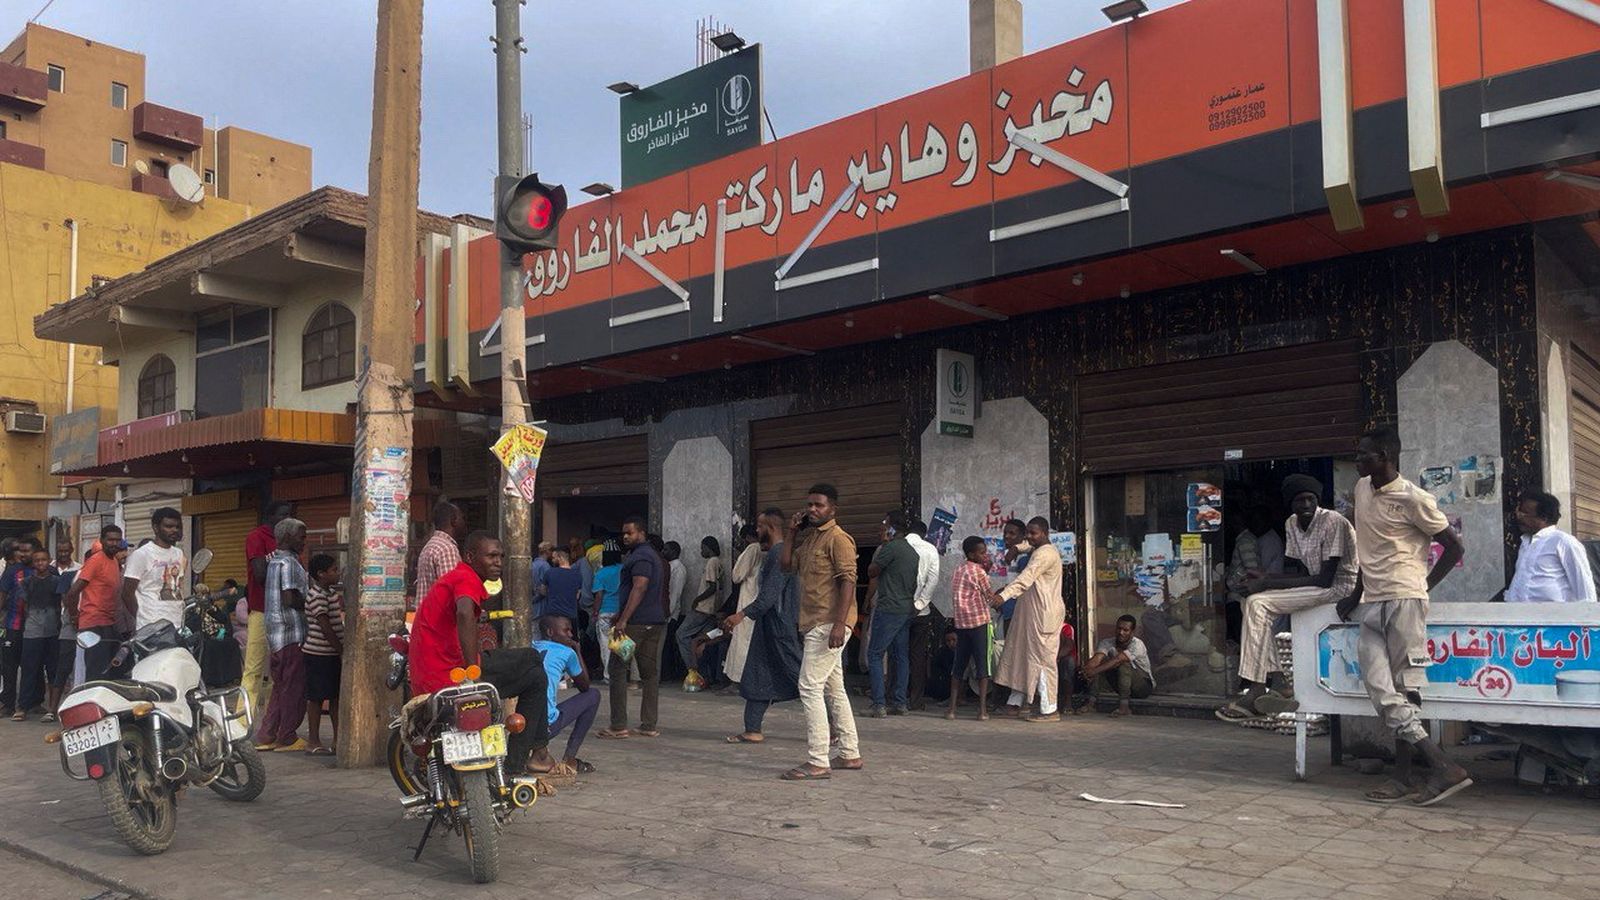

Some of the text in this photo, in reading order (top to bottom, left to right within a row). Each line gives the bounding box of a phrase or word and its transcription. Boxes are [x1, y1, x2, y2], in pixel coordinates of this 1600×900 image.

[627, 102, 708, 143] مخبز الفاروق
[987, 66, 1114, 175] مخبز
[1209, 101, 1265, 123] 0912902500
[671, 127, 690, 146] للخبز
[633, 202, 709, 256] محمد
[1427, 626, 1591, 668] ألبان الفارو
[1485, 677, 1505, 690] 24
[67, 736, 97, 755] 63202
